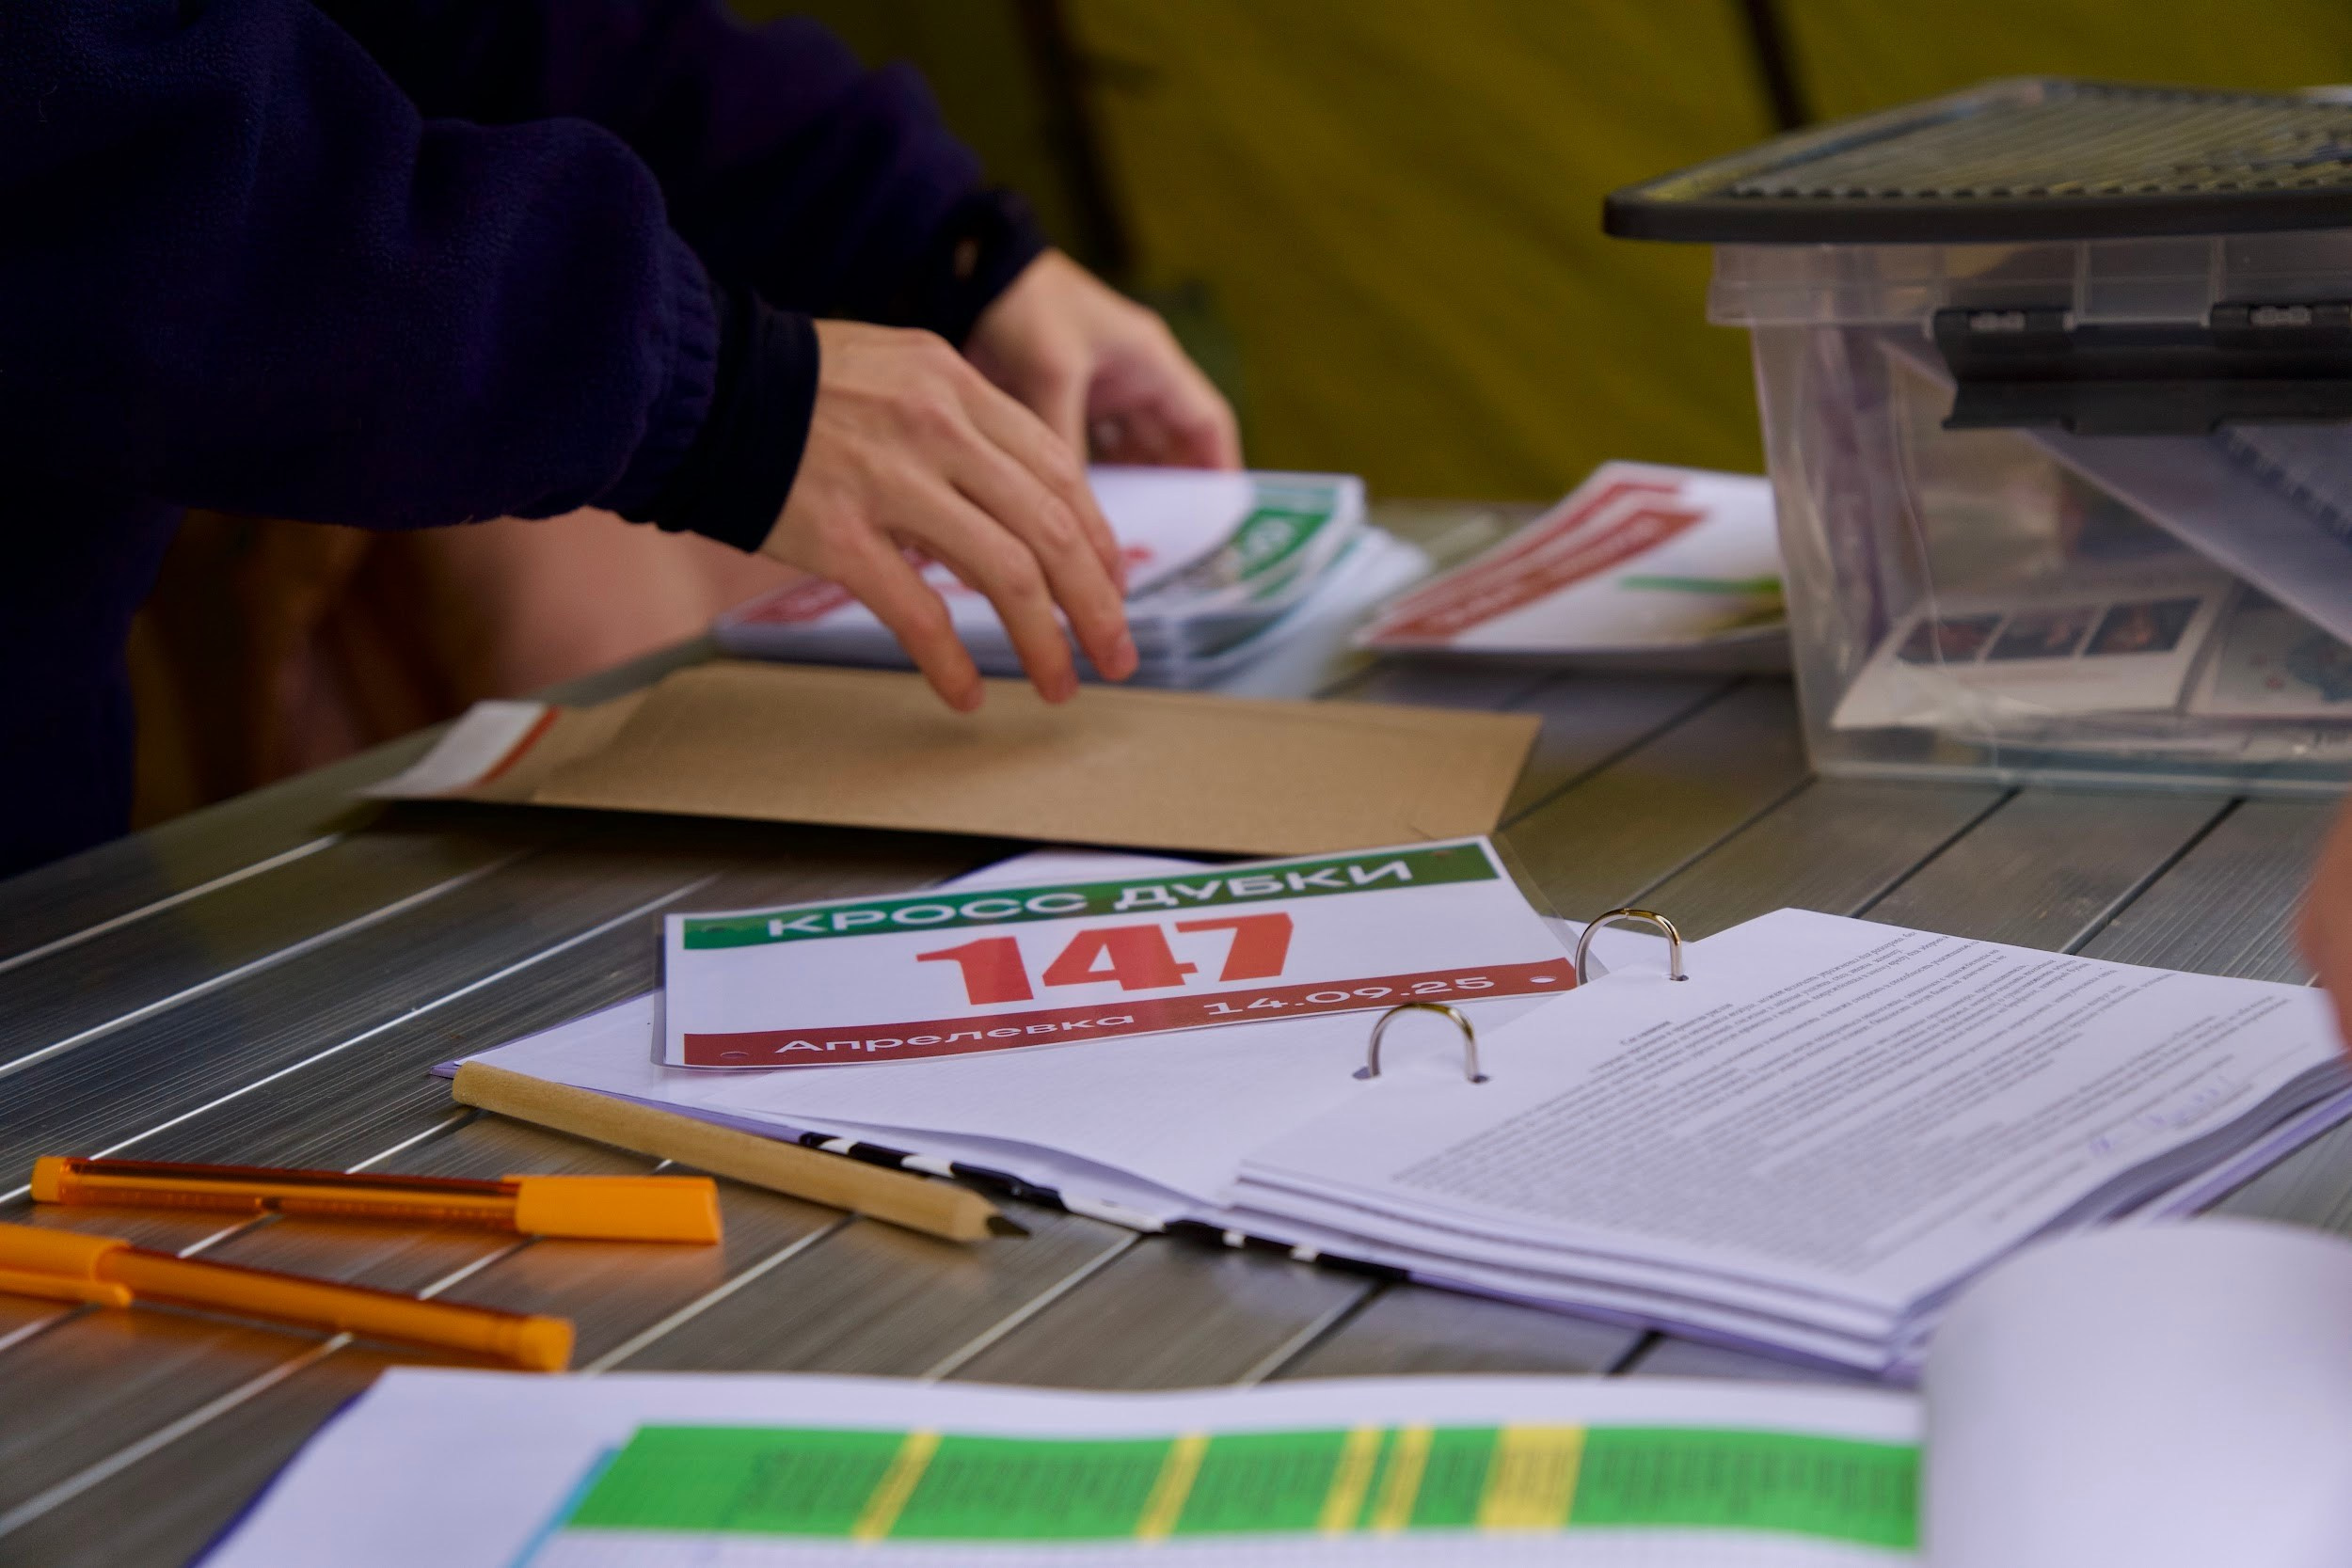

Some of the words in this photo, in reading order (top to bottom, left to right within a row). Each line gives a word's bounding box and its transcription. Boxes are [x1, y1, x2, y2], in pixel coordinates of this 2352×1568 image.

[767, 893, 1088, 937] КРОСС
[1113, 860, 1412, 910] ДУБКИ
[917, 912, 1293, 1006] 147
[774, 1013, 1135, 1053] Апрелевка
[1204, 976, 1496, 1015] 14.09.25
